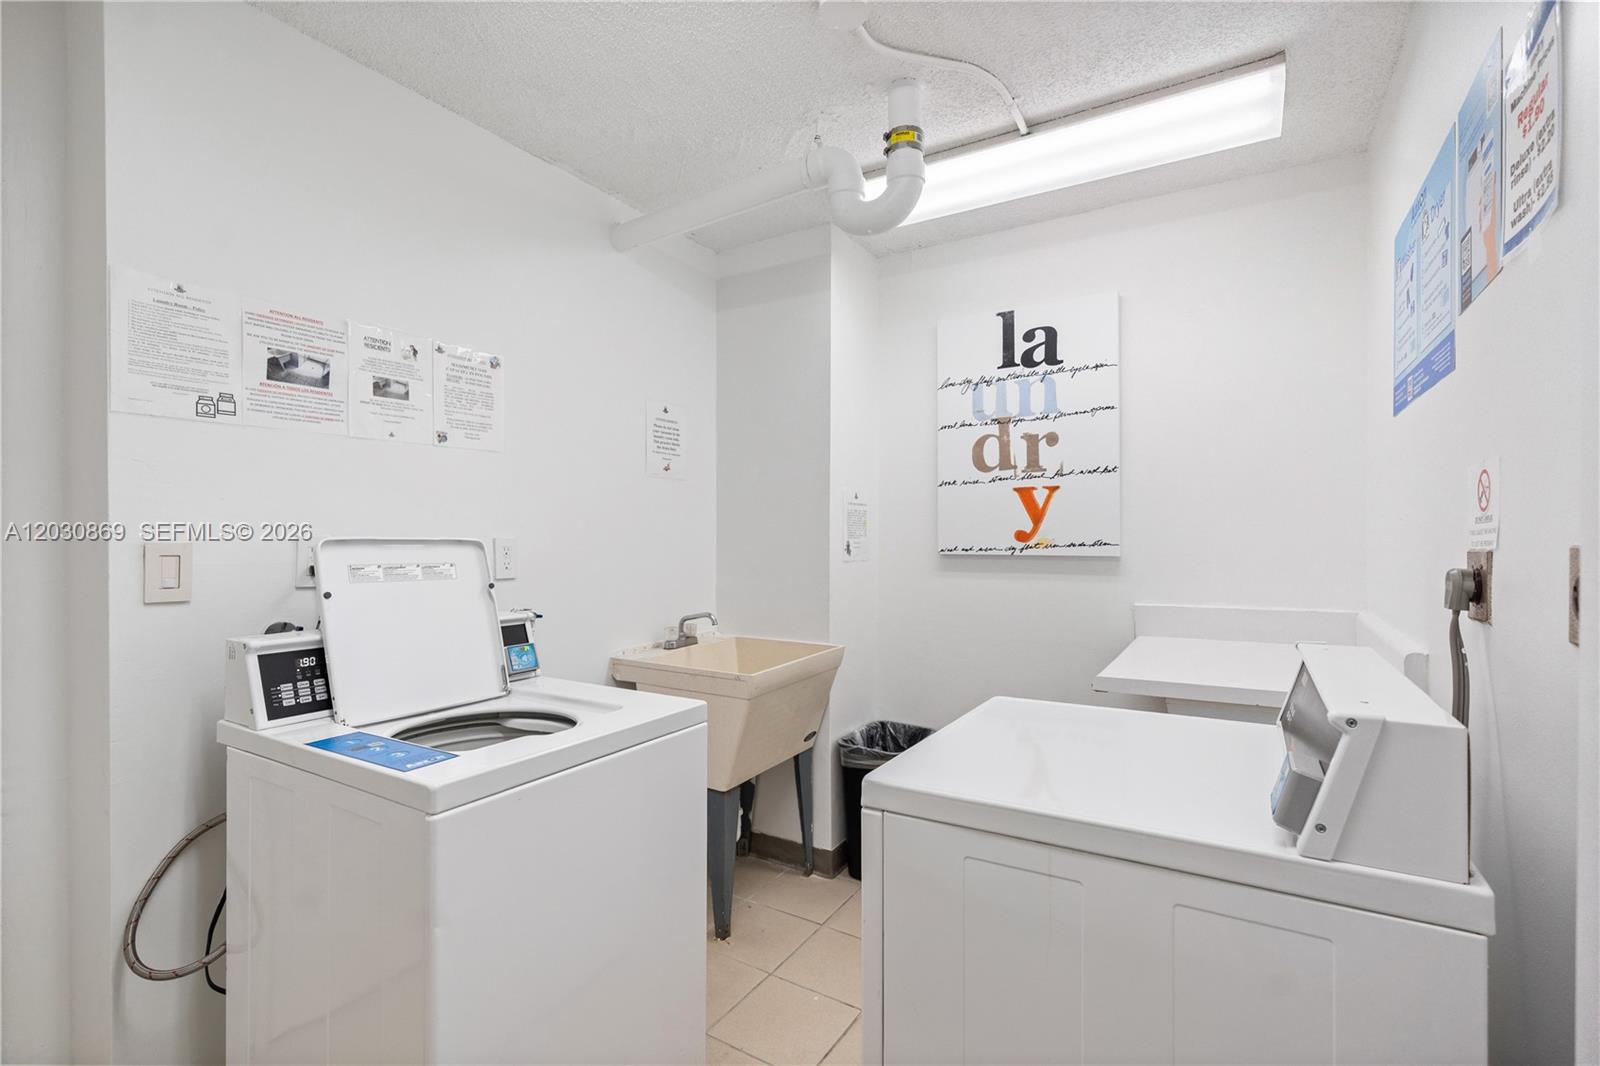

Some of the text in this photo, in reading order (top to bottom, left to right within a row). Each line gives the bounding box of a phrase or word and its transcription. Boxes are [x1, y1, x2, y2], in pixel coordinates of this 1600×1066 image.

[1517, 72, 1548, 128] Regular
[1522, 98, 1544, 139] $1.90
[1510, 141, 1534, 177] Deluxe
[1513, 188, 1532, 213] Ultra
[996, 310, 1064, 370] la
[972, 375, 1059, 422] un
[972, 416, 1060, 474] dr
[1012, 485, 1061, 544] y
